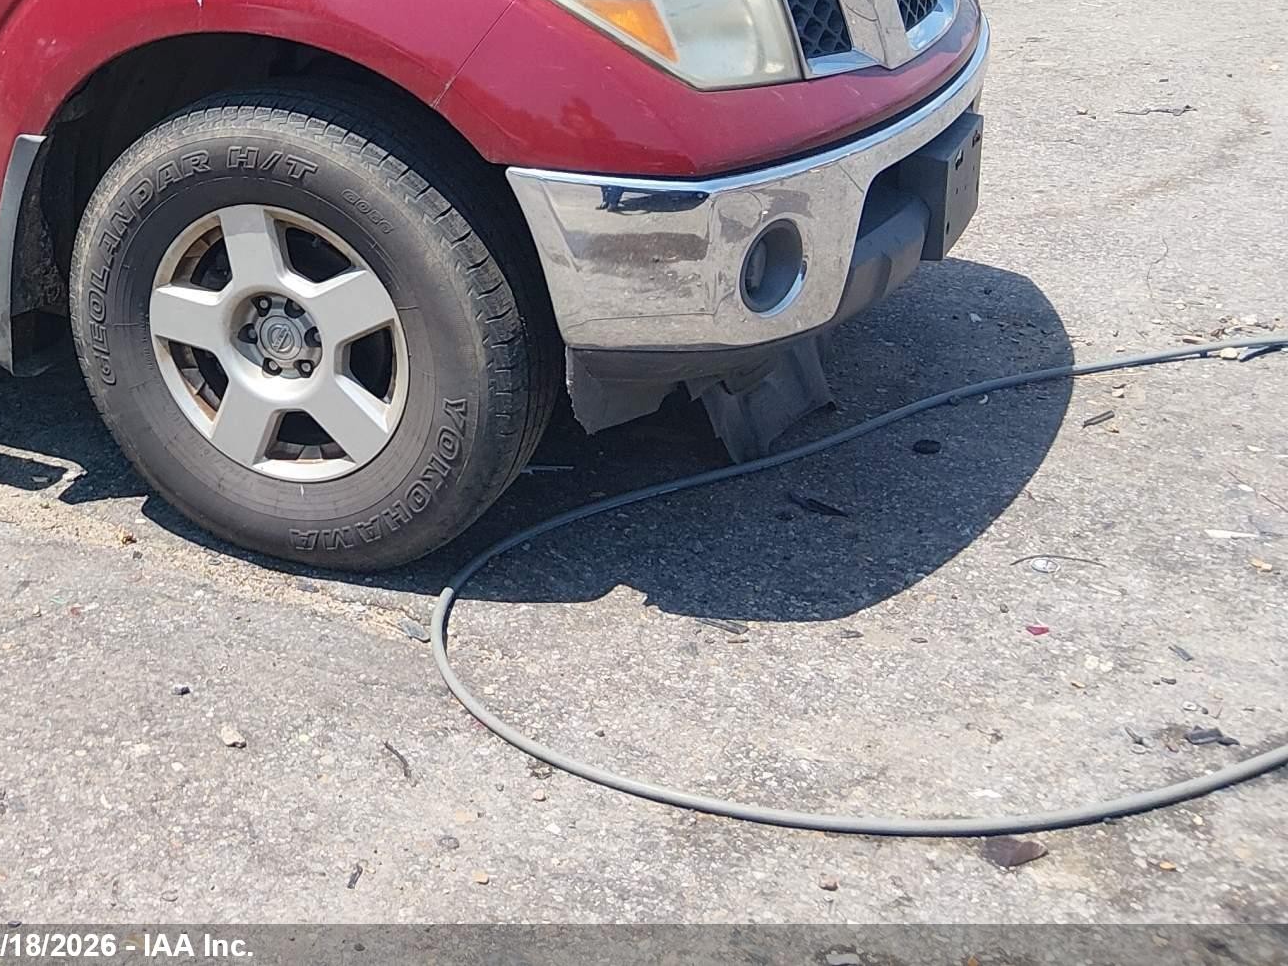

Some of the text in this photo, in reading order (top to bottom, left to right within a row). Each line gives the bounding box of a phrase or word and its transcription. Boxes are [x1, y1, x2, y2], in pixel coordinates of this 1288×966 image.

[88, 149, 211, 386] GEOLANDAR
[226, 145, 319, 179] H/T
[289, 397, 468, 551] YOKOHAMA
